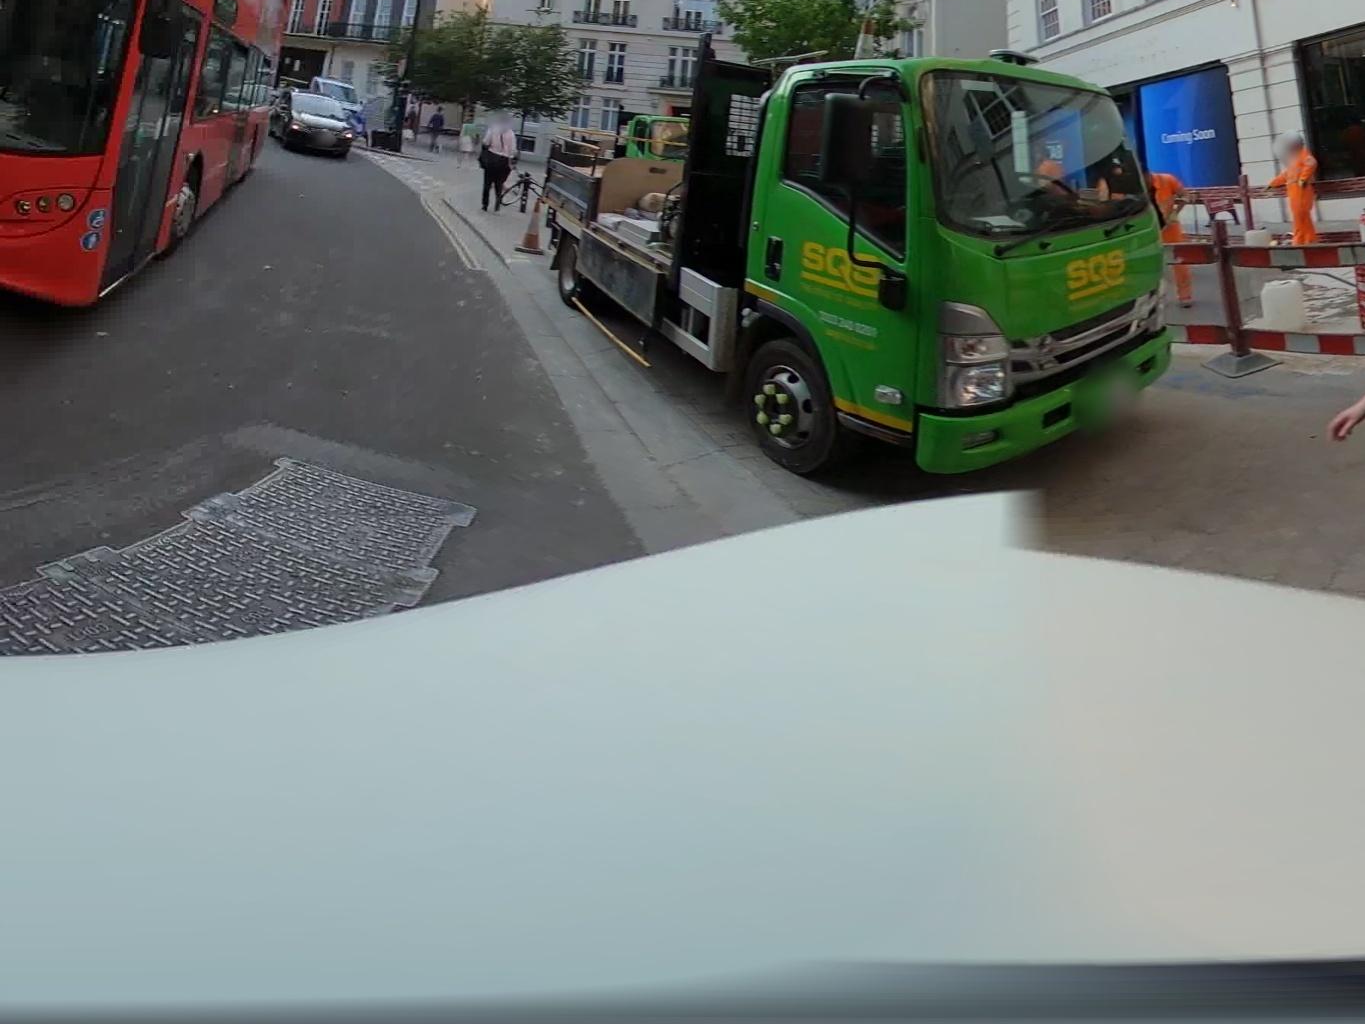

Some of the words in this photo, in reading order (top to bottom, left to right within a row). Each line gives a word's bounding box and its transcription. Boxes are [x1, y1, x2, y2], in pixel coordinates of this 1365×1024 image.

[1161, 131, 1193, 144] Coming
[1193, 128, 1216, 141] Soon
[802, 241, 884, 287] SQS
[1066, 249, 1126, 290] SQS
